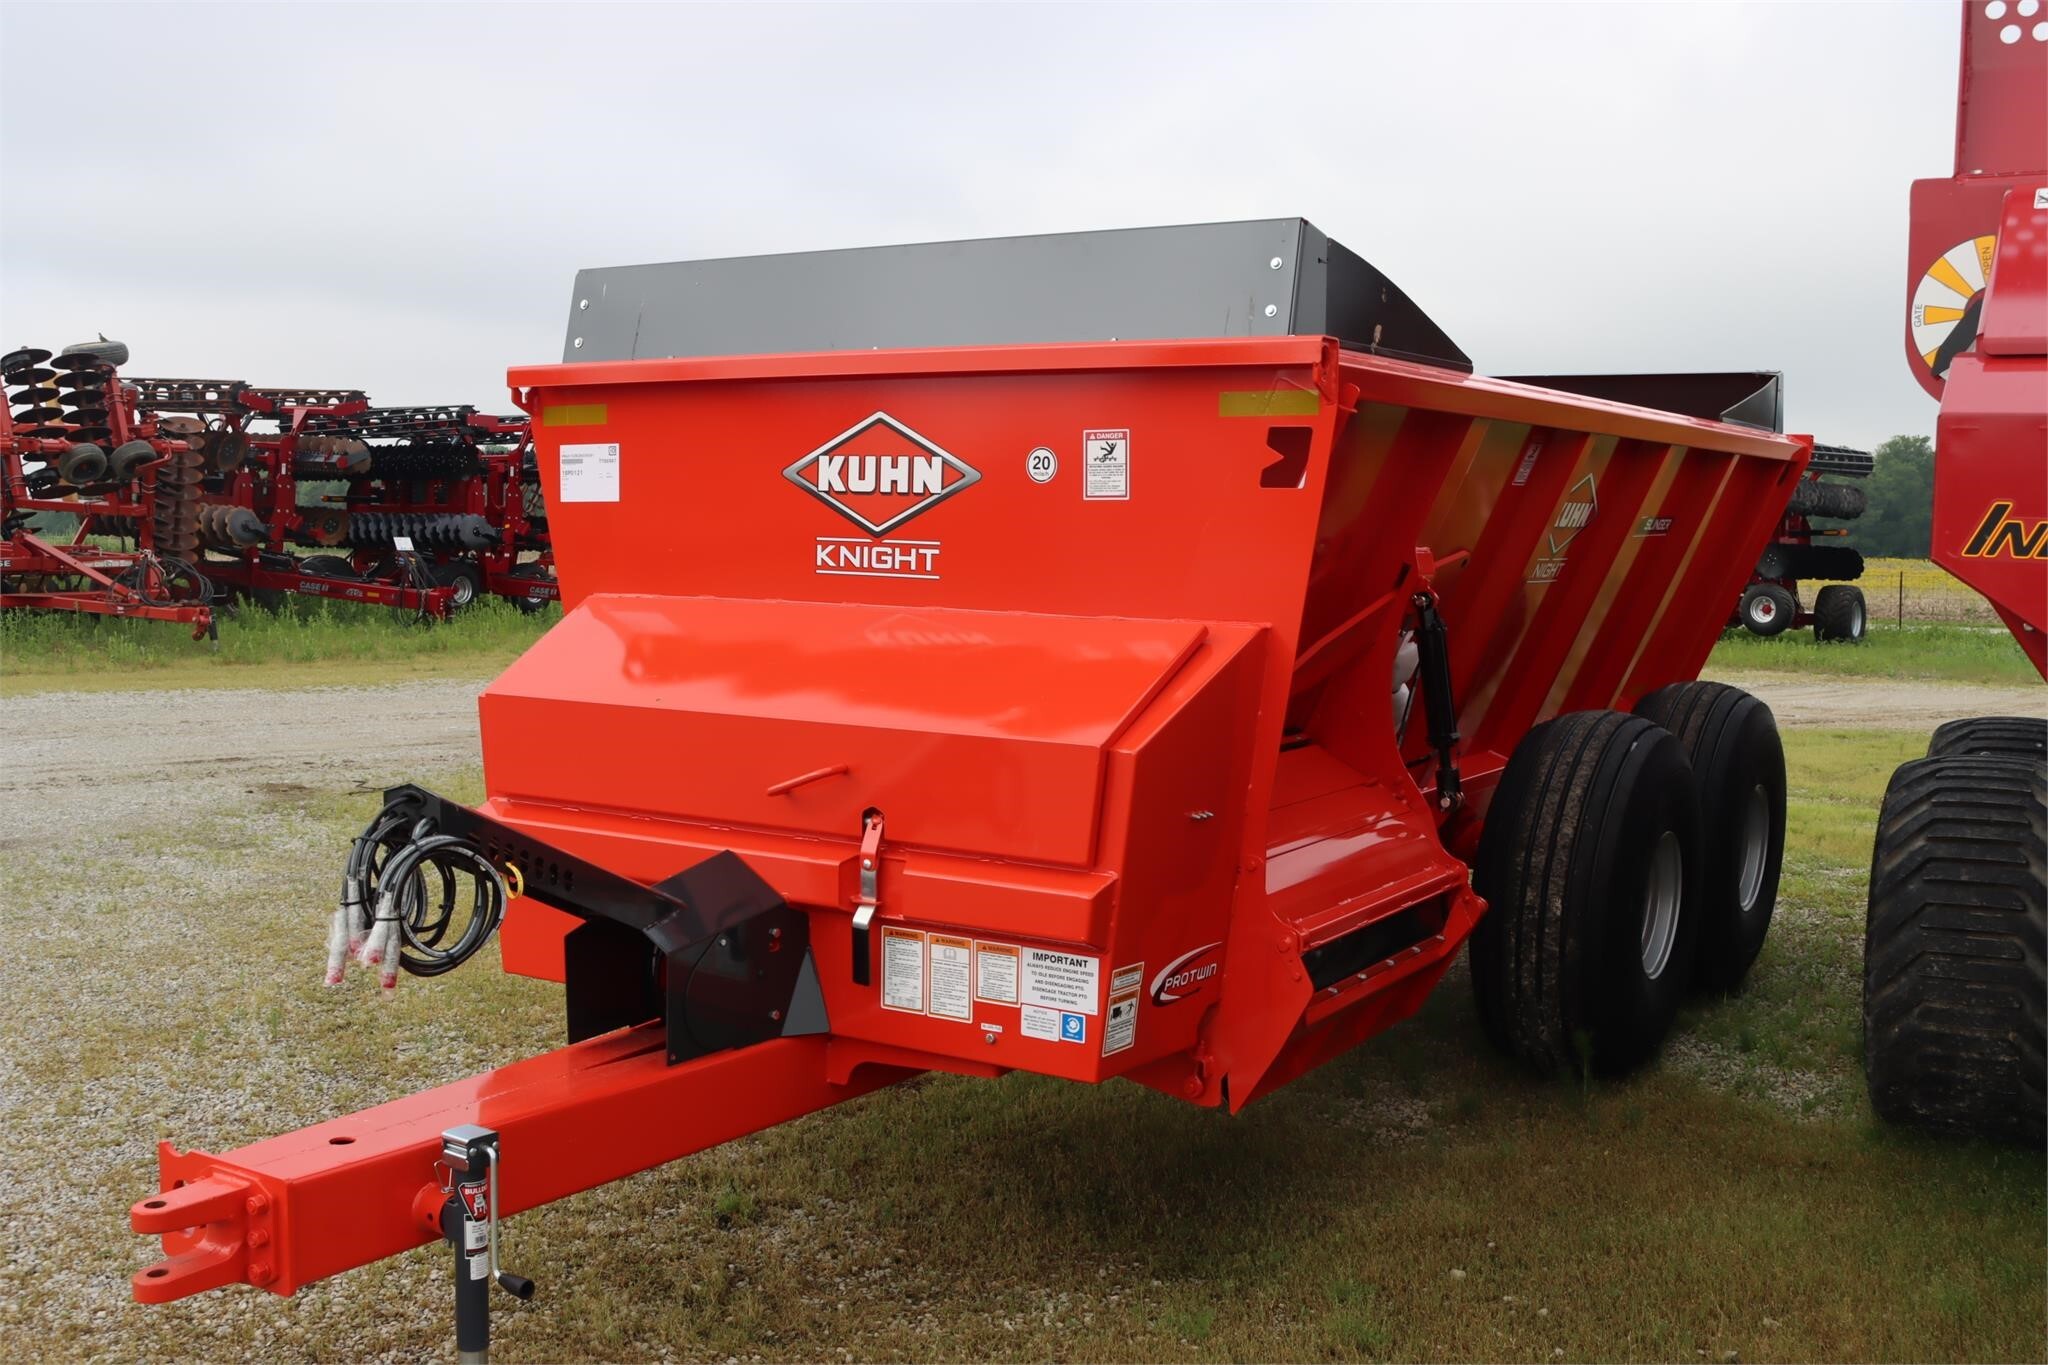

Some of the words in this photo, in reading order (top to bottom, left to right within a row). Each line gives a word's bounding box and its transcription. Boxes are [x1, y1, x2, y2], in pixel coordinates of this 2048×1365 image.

[1913, 303, 1923, 328] GATE
[1032, 455, 1051, 471] 20
[817, 455, 943, 494] KUHN
[816, 544, 940, 571] KNIGHT
[300, 581, 320, 590] CASE
[529, 586, 550, 595] CASE
[1032, 952, 1088, 968] IMPORTANT
[1063, 967, 1079, 975] ENGINE
[1066, 976, 1089, 984] ENGAGING
[1032, 986, 1057, 994] DISENGAGE
